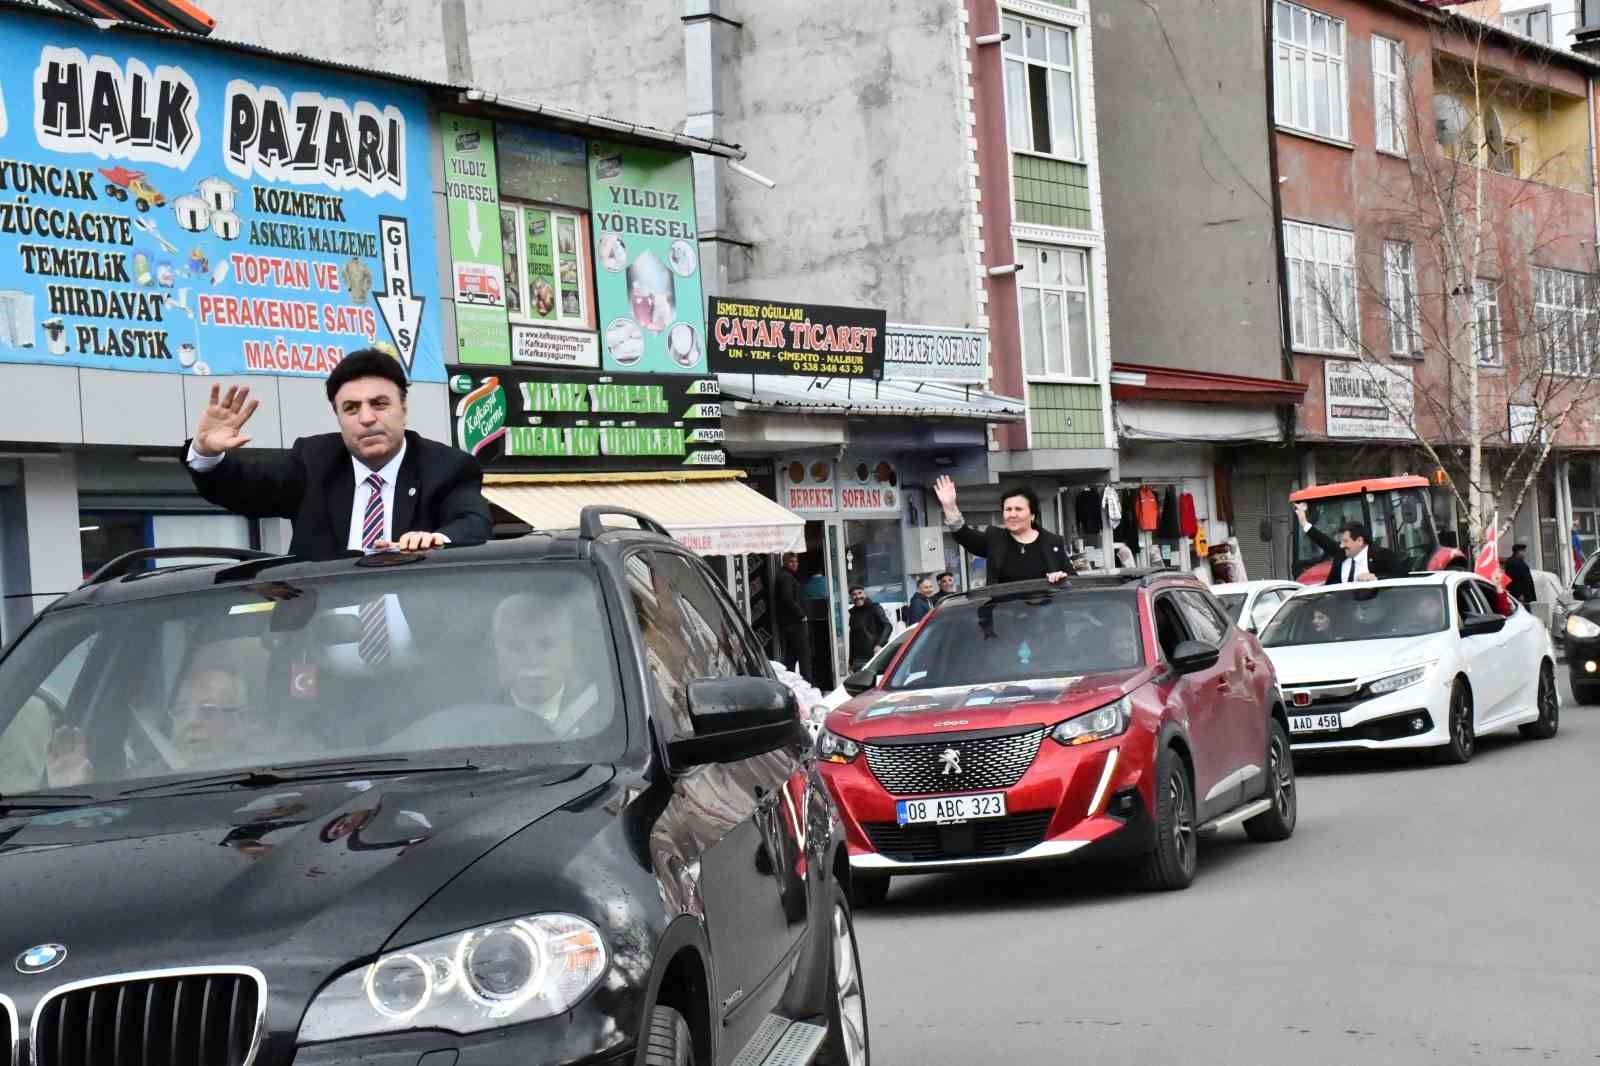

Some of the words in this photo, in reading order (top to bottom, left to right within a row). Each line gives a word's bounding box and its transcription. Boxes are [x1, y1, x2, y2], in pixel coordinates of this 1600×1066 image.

[42, 61, 194, 154] HALK
[229, 93, 402, 187] PAZARI
[450, 158, 488, 178] YILDIZ
[609, 185, 680, 211] YILDIZ
[597, 209, 695, 240] YÖRESEL
[308, 227, 378, 258] MALZEME
[231, 255, 310, 289] TOPTAN
[313, 263, 339, 291] VE
[48, 285, 164, 322] HIRDAVAT
[761, 305, 804, 320] OĞULLARI
[199, 295, 319, 331] PERAKENDE
[324, 306, 377, 342] SATIŞ
[715, 316, 786, 352] ÇATAK
[790, 318, 877, 354] TİCARET
[728, 350, 743, 359] UN
[751, 352, 770, 360] YEM
[884, 333, 934, 364] BEREKET
[936, 336, 981, 366] SOFRASI
[803, 364, 819, 372] 538
[852, 366, 864, 374] 39
[519, 382, 588, 412] YILDIZ
[700, 382, 719, 393] BAL
[701, 406, 720, 417] KAZ
[790, 488, 833, 509] BEREKET
[842, 488, 881, 509] SOFRASI
[1292, 717, 1312, 730] AAD
[1318, 715, 1337, 728] 458
[908, 803, 927, 820] 08
[937, 800, 965, 818] ABC
[971, 796, 1001, 814] 323
